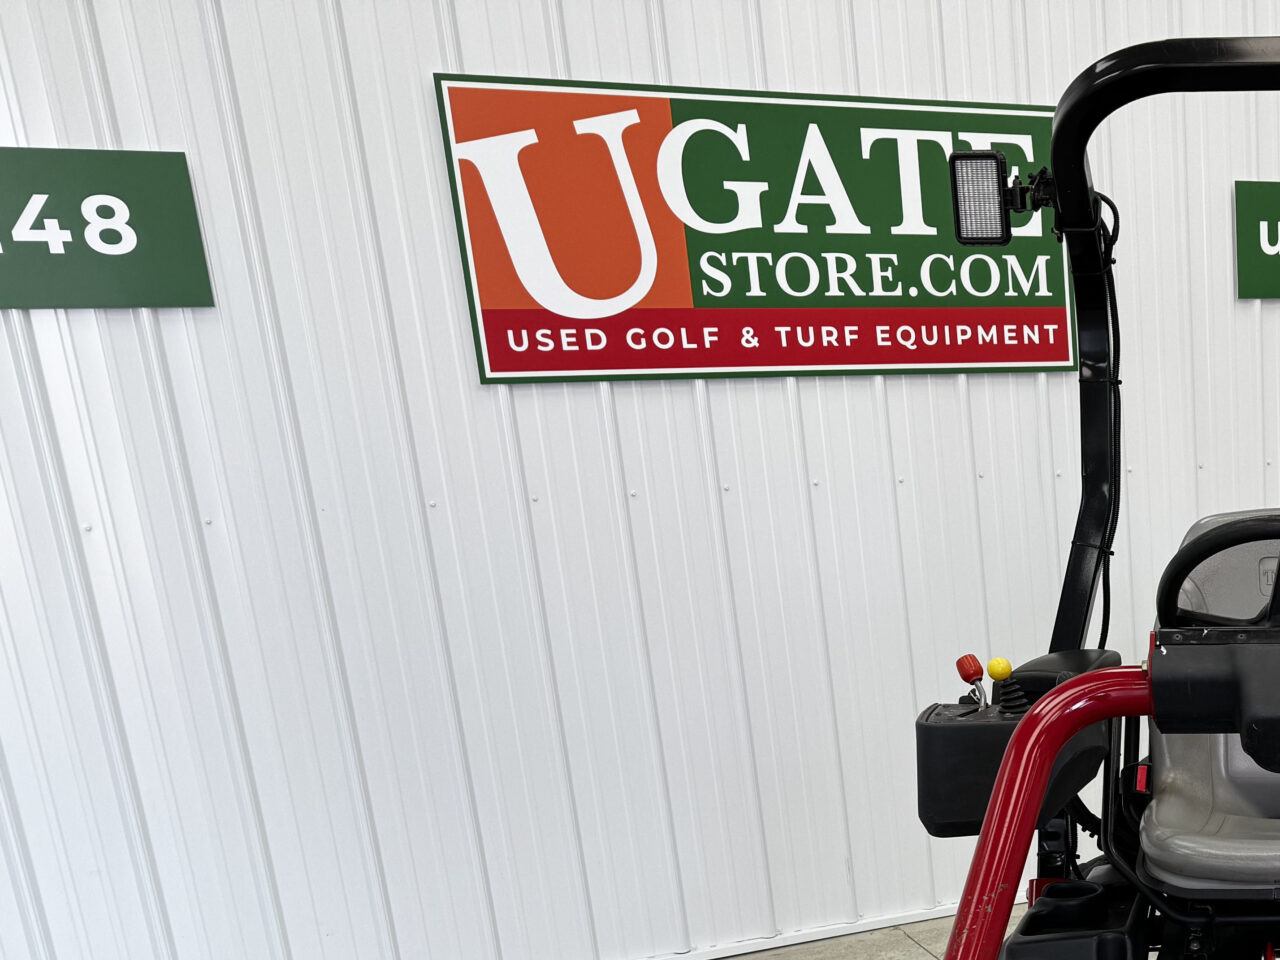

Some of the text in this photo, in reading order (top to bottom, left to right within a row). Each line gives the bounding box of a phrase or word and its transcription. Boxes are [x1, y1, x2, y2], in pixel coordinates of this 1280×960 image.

[0, 193, 138, 256] 48
[701, 251, 1053, 298] STORE.COM
[507, 324, 1059, 352] USED GOLF & TURF EQUIPMENT
